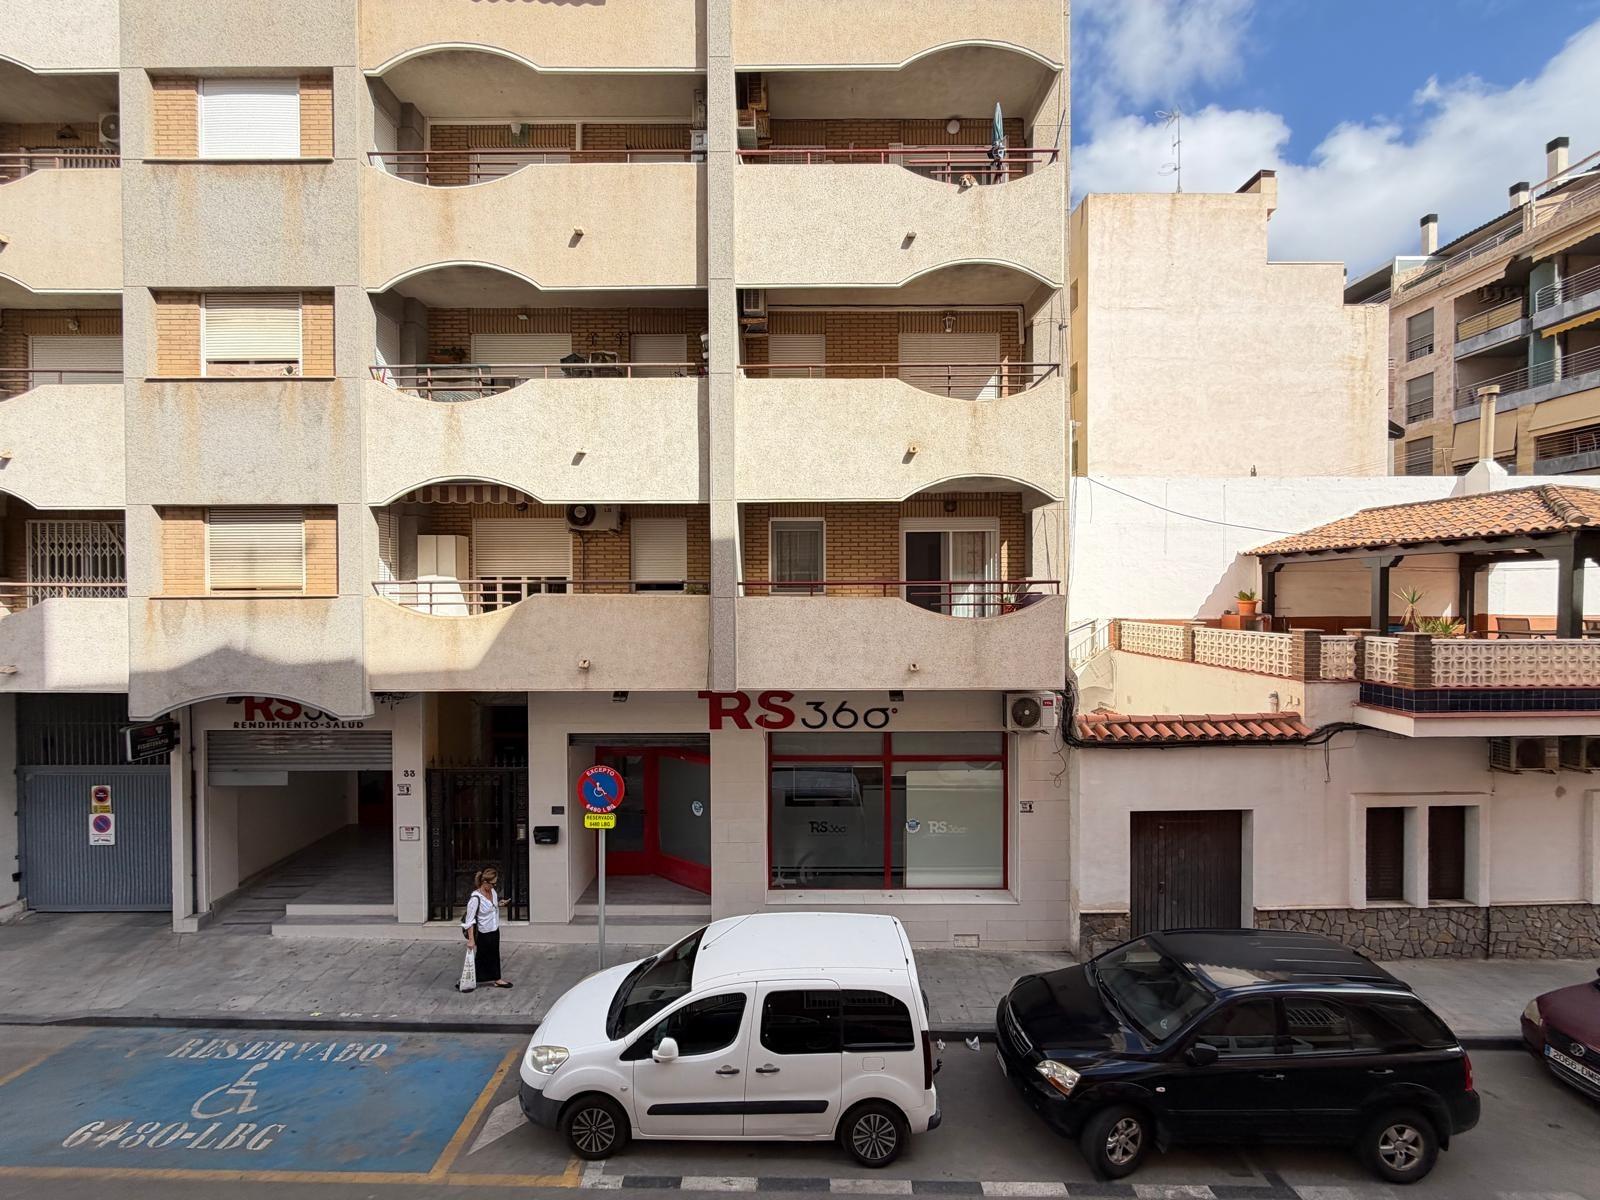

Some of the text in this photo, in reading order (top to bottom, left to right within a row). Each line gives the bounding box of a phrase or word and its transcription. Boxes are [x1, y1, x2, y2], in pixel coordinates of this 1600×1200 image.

[404, 770, 416, 778] 33
[586, 768, 615, 776] EXCEPTO
[165, 1039, 388, 1062] RESERVADO
[61, 1120, 288, 1151] 6480-LBG
